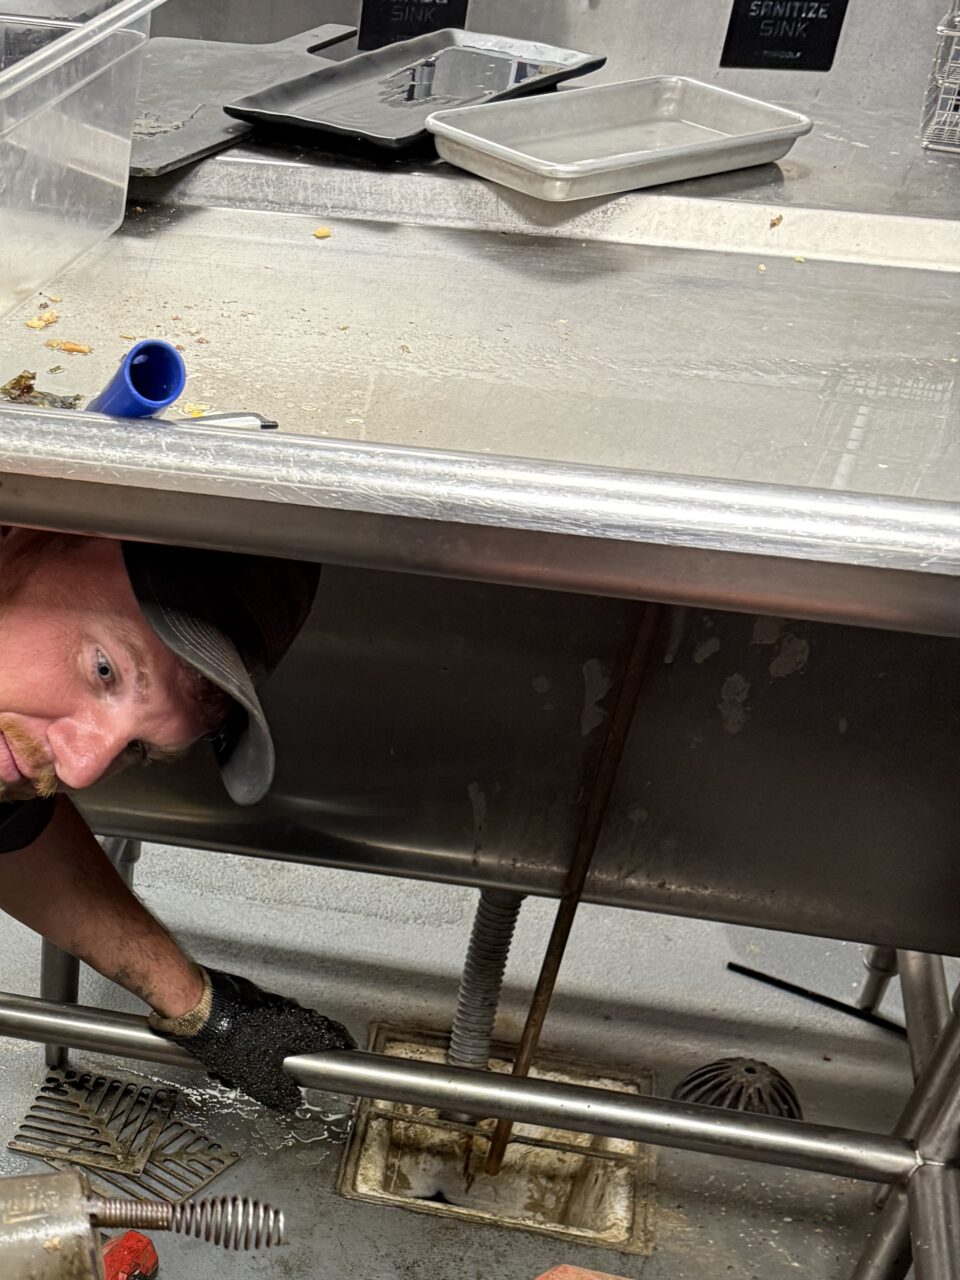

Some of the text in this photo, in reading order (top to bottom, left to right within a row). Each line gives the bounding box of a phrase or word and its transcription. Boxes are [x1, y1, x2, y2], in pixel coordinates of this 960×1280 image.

[391, 5, 437, 22] SINK
[749, 0, 830, 18] SANITIZE
[760, 20, 809, 37] SINK
